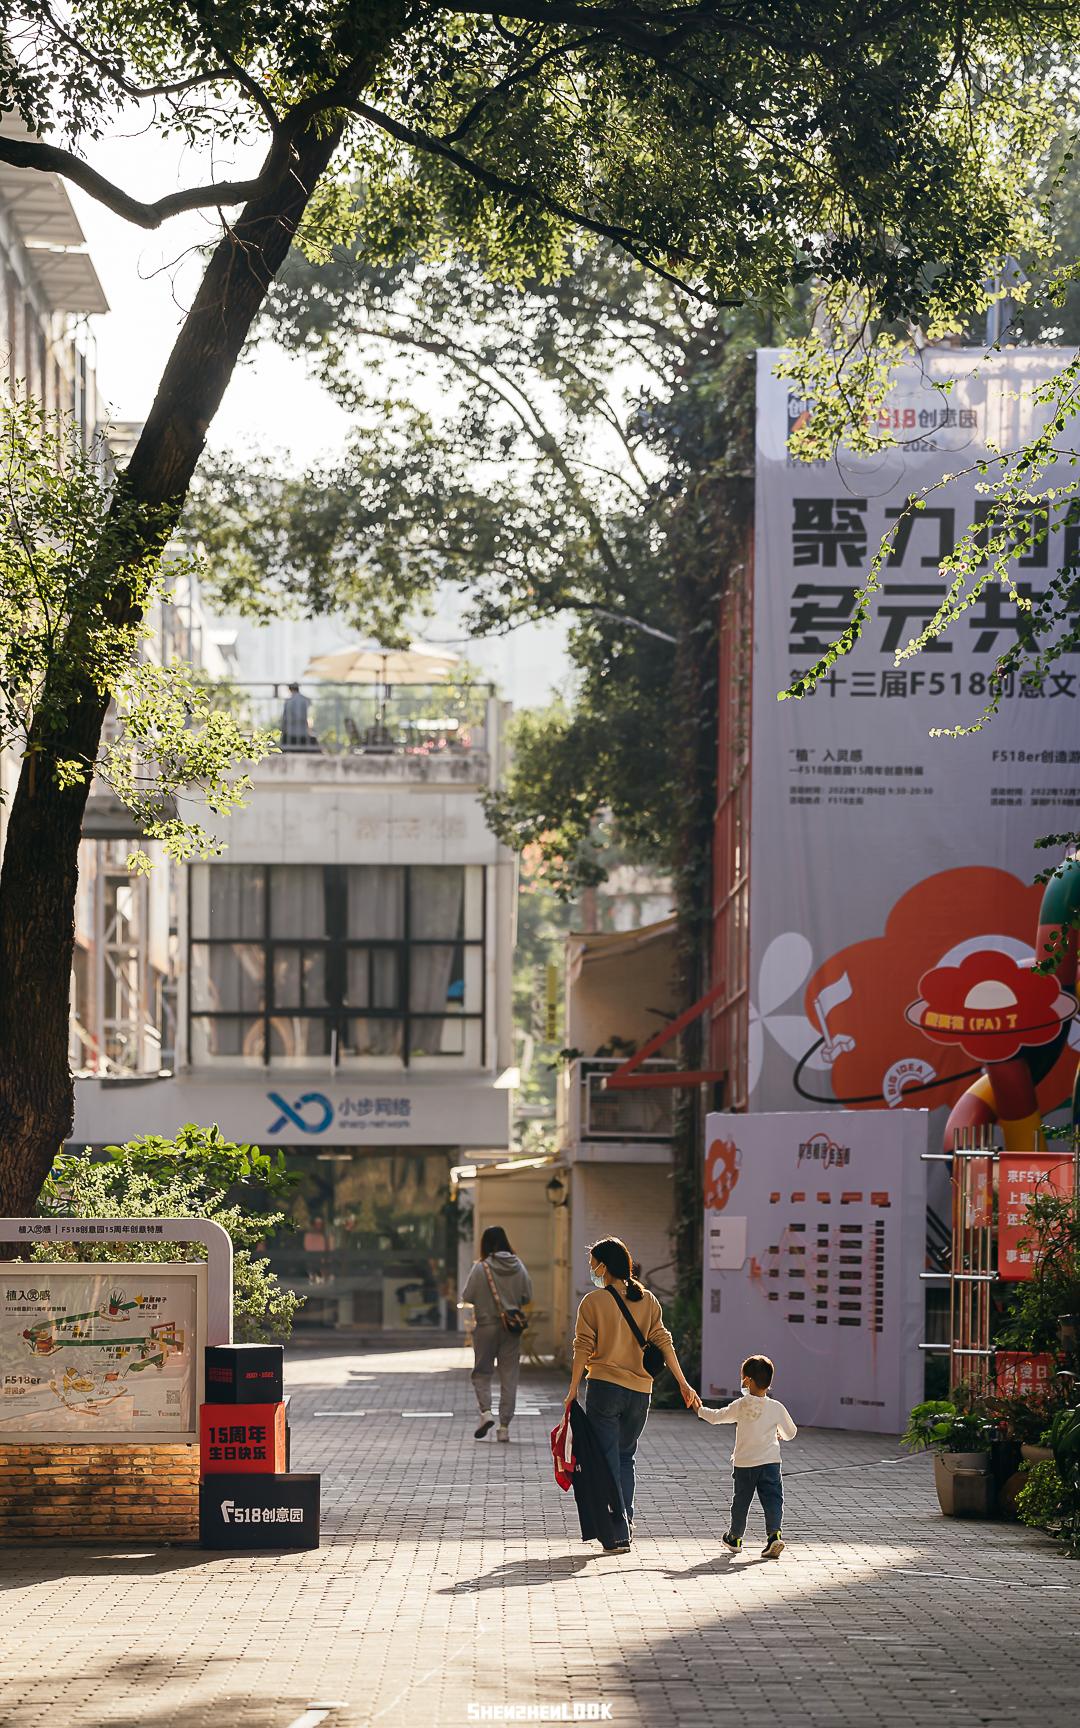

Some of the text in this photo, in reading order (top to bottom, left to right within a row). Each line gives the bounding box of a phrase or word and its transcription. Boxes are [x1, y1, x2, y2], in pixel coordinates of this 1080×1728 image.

[789, 584, 1080, 653] 多元共
[338, 1098, 411, 1117] 小步网络
[6, 1289, 51, 1301] 植入灵感
[5, 1376, 41, 1385] F518er
[209, 1426, 266, 1444] 15周年
[209, 1447, 266, 1460] 生日快乐
[220, 1500, 304, 1523] F518创意园
